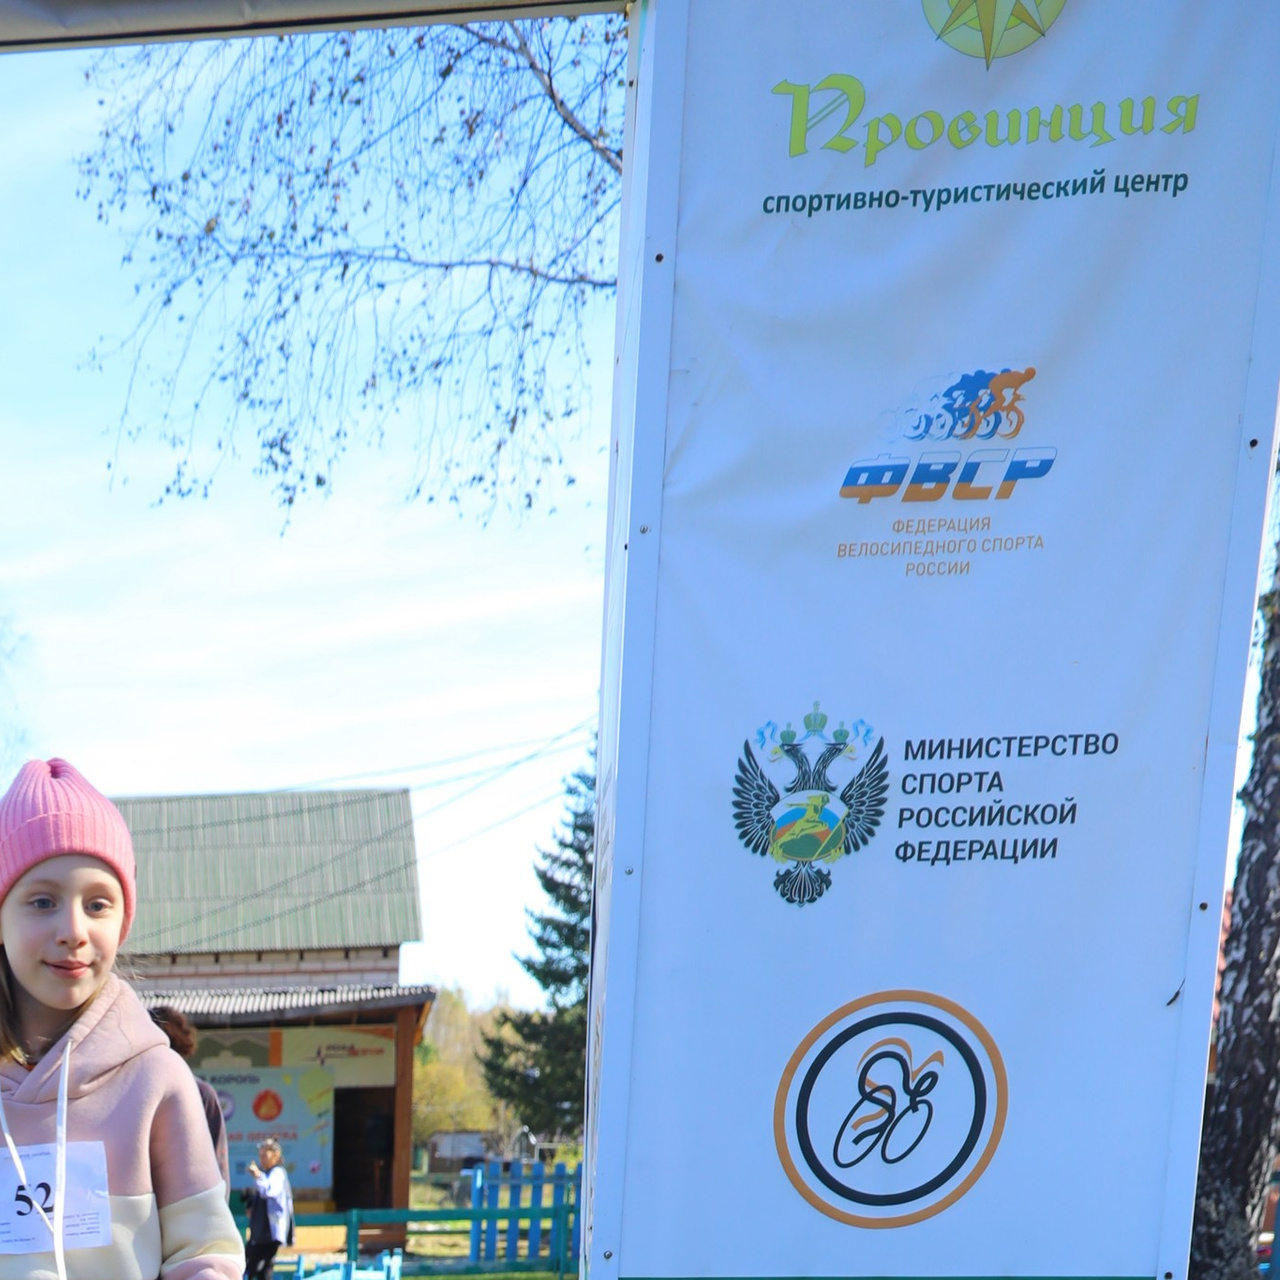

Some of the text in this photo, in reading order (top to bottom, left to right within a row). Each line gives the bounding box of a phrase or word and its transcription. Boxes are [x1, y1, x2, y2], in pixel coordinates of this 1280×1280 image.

[771, 73, 1200, 168] Провинция
[762, 168, 1189, 217] спортивно-туристический центр
[838, 446, 1058, 504] ФВСР
[892, 516, 992, 536] ФЕДЕРАЦИЯ
[836, 534, 1044, 559] ВЕЛОСИПЕДНОГО СПОРТА
[905, 560, 971, 578] РОССИИ
[903, 732, 1119, 761] МИНИСТЕРСТВО
[901, 771, 1004, 795] СПОРТА
[897, 797, 1077, 829] РОССИЙСКОЙ
[894, 837, 1058, 866] ФЕДЕРАЦИИ
[14, 1182, 54, 1216] 52
